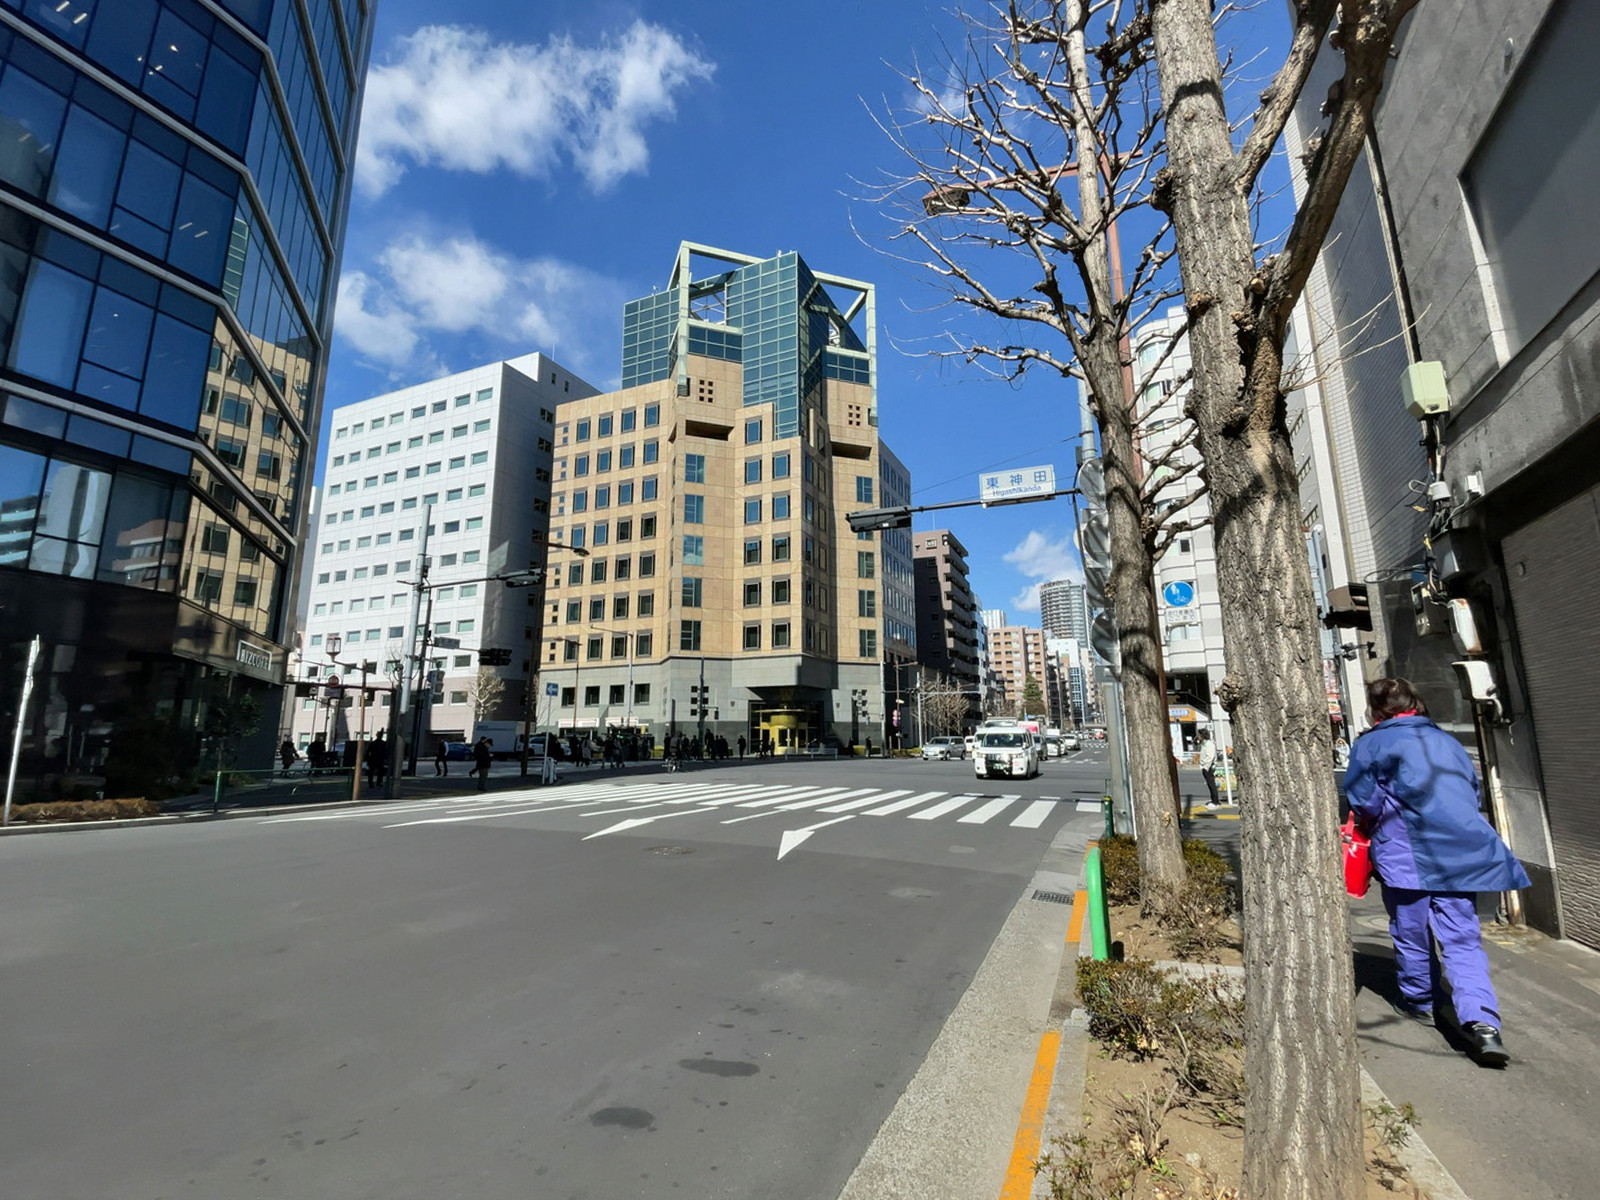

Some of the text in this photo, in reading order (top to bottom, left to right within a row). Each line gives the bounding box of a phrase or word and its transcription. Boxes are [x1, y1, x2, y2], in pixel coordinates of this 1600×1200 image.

[986, 471, 1046, 489] 東神田
[993, 485, 1041, 496] Higashikanda
